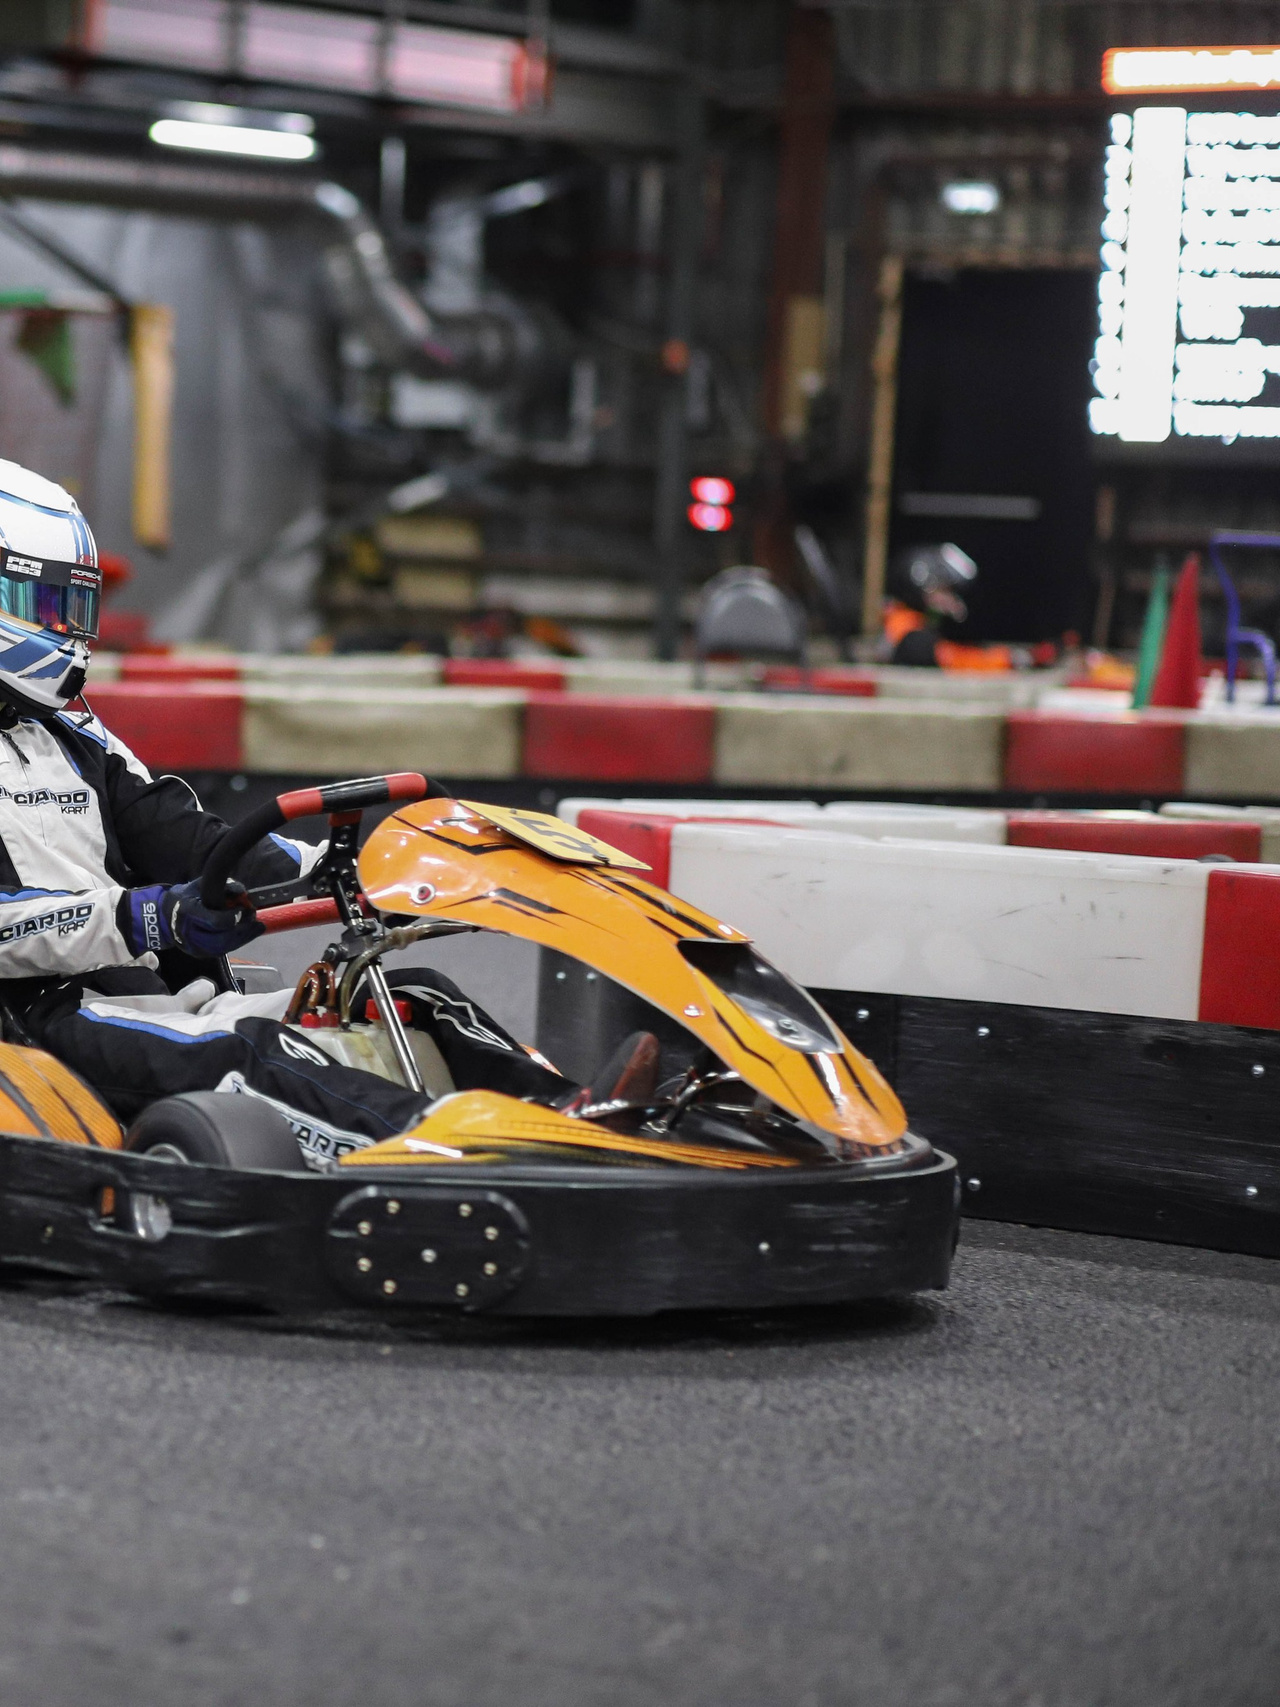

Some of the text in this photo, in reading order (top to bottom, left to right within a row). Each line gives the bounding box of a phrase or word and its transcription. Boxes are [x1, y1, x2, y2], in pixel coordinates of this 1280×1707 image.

[7, 555, 43, 569] PPM
[5, 563, 42, 577] 963
[70, 569, 101, 581] PORSCH
[61, 806, 89, 815] KART
[58, 918, 89, 937] KAR
